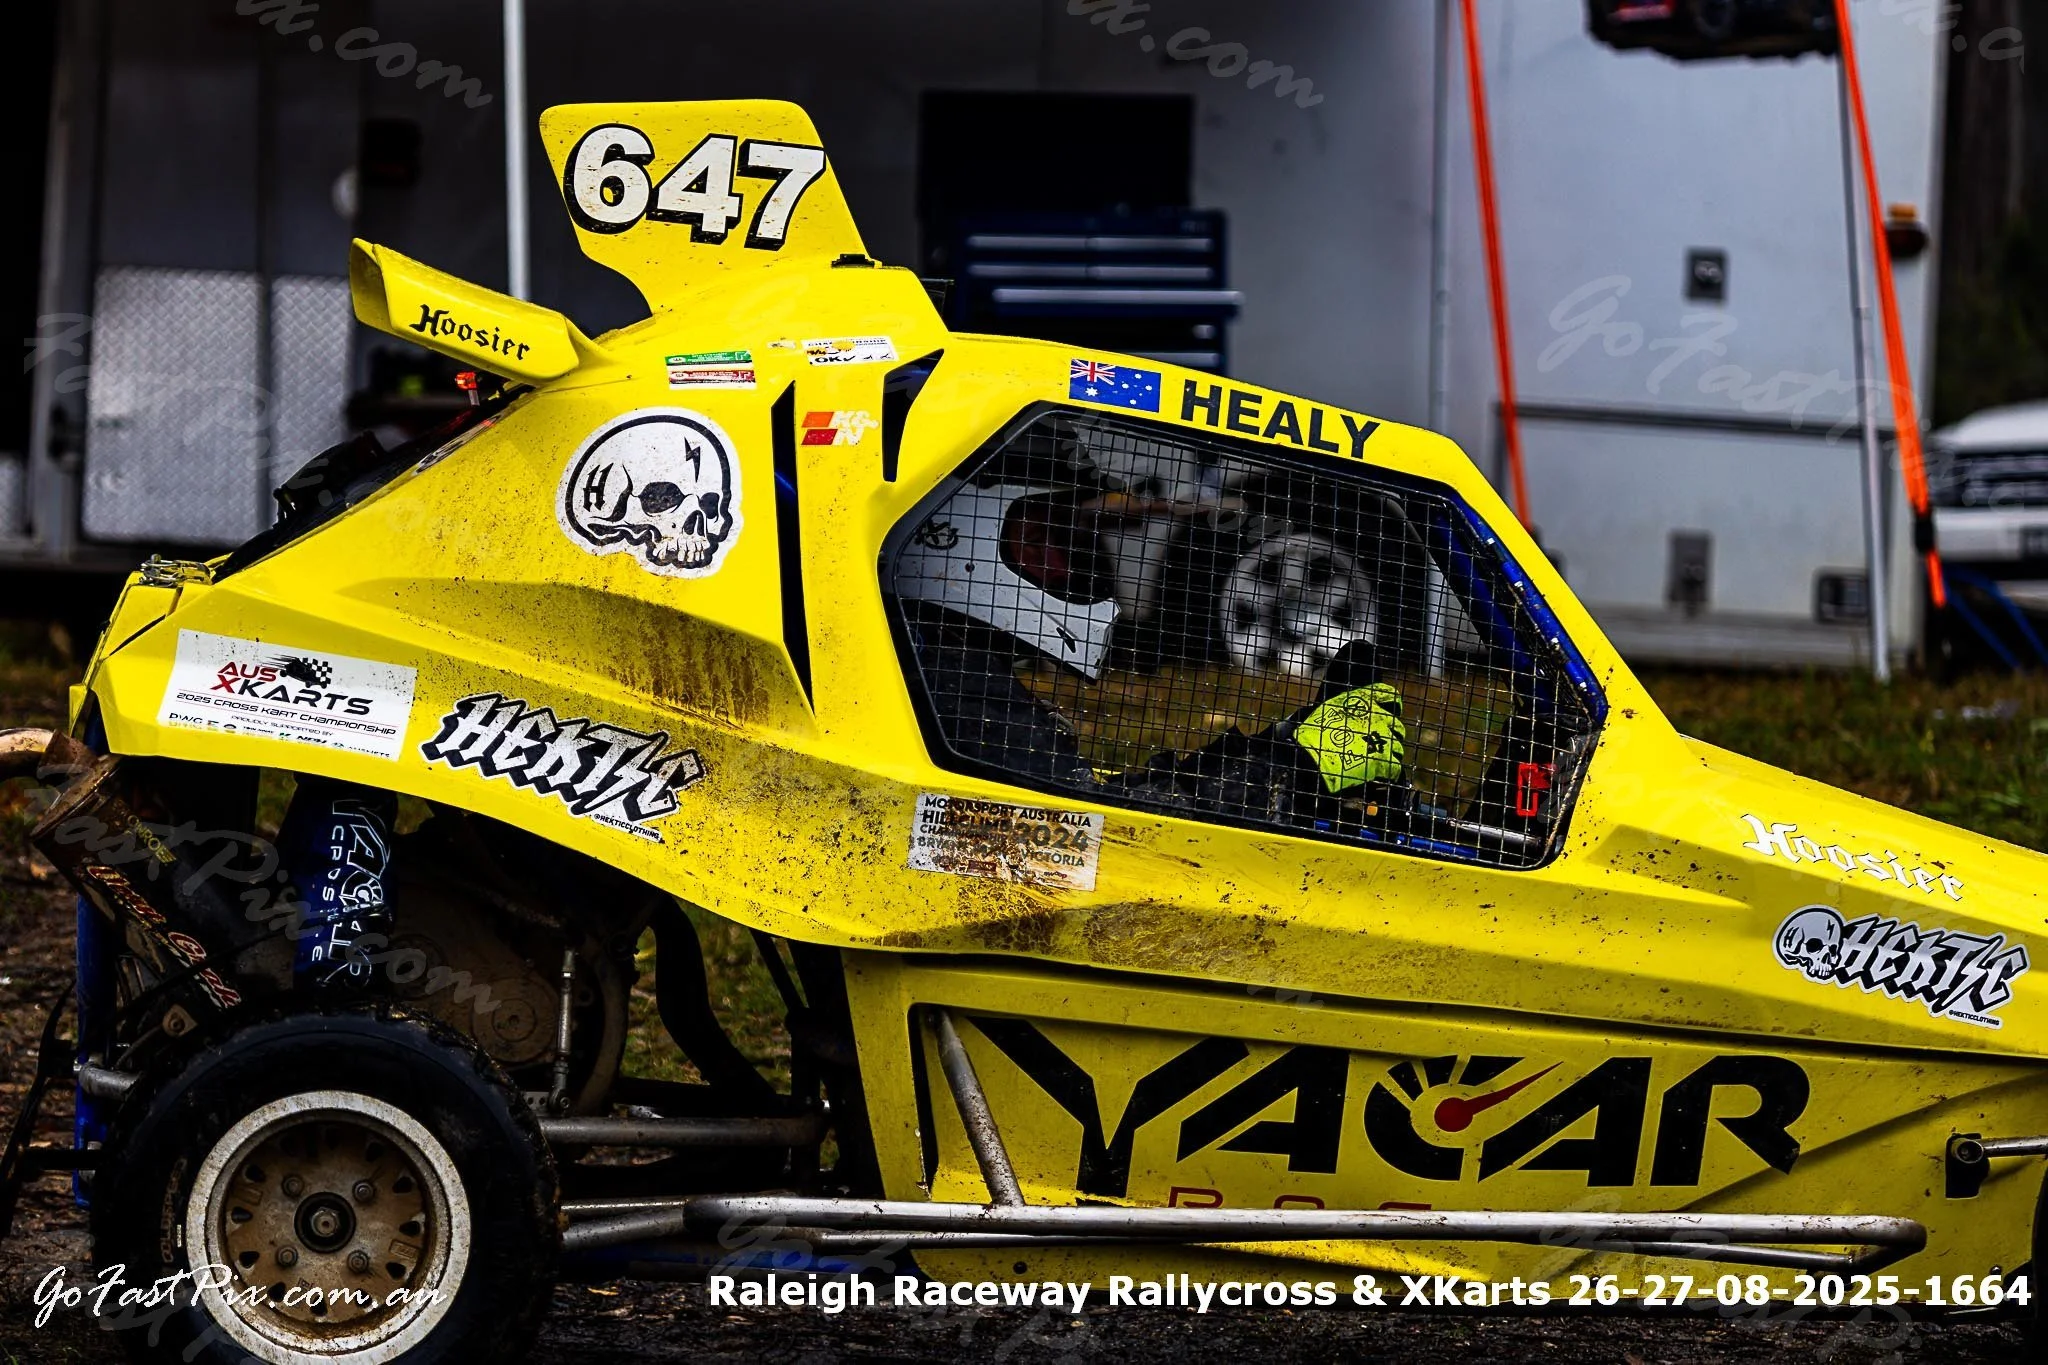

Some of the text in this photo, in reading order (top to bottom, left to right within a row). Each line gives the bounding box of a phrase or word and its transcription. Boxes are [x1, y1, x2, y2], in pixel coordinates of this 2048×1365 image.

[563, 123, 827, 250] 647
[409, 304, 530, 360] Hoosier
[1181, 379, 1380, 459] HEALY
[217, 661, 278, 682] AUS
[176, 693, 396, 735] 2025 CROSS KART CHAMPIONSHIP
[210, 675, 373, 716] XKARTS
[231, 715, 268, 726] PROUDLY
[270, 722, 321, 735] SUPPORTED
[594, 813, 660, 839] @HEKTICCLOTHING
[925, 797, 1092, 828] MOTORSPORT AUSTRALIA
[1014, 823, 1089, 853] 2024
[1740, 813, 1964, 901] Hoosier
[1948, 1009, 1999, 1026] @HEKTICCLOTHING
[966, 1016, 1811, 1197] YACAR
